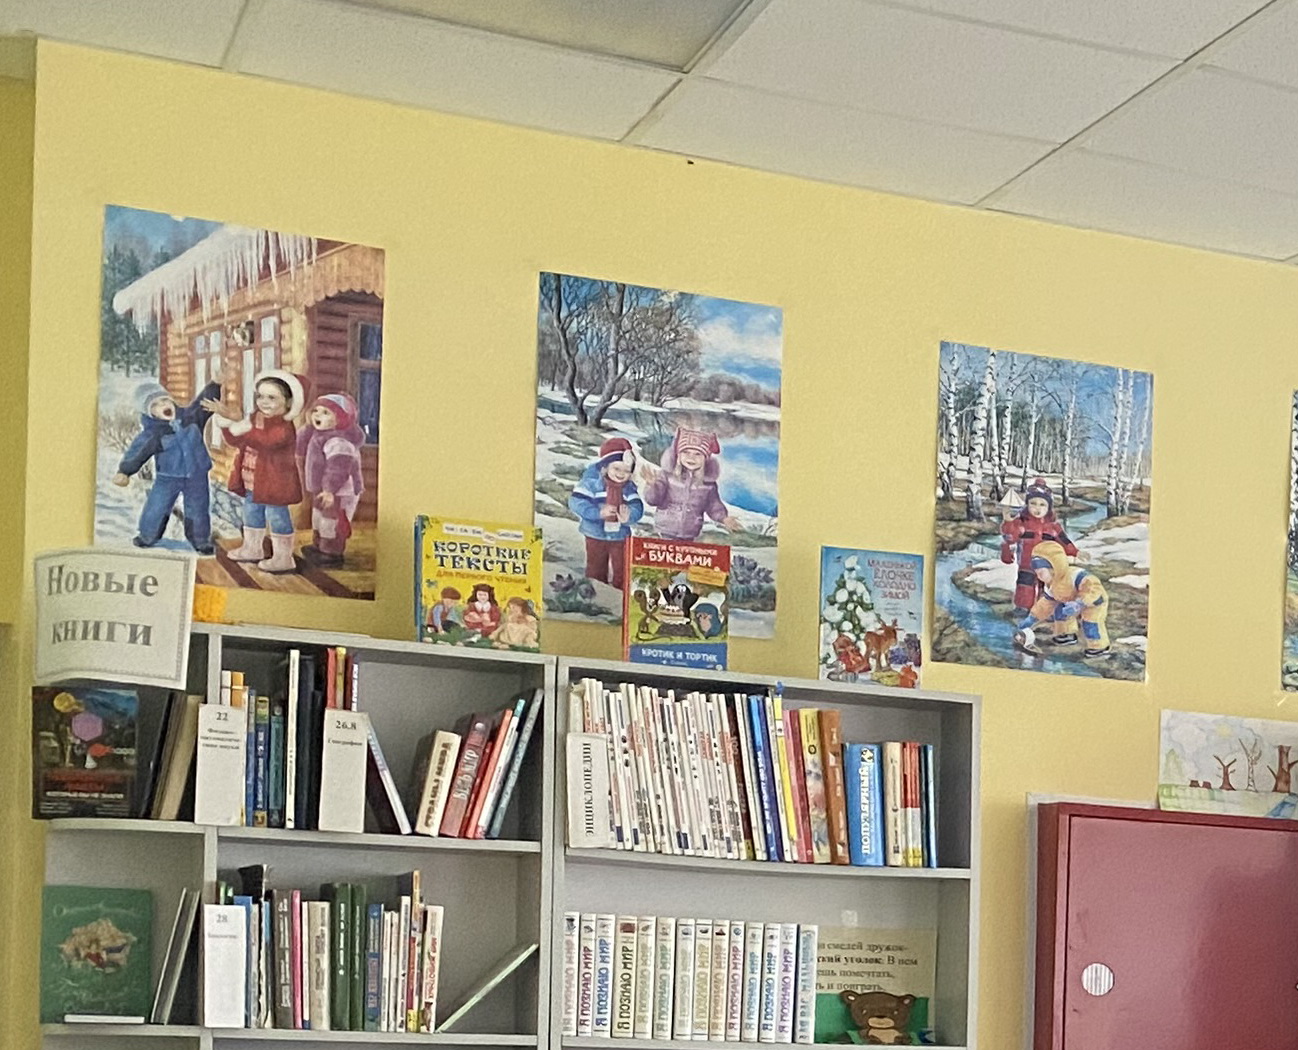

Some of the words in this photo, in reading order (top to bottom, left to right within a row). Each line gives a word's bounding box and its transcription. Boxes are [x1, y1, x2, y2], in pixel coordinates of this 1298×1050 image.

[433, 541, 531, 560] КОРОТКИЕ
[648, 550, 712, 567] БУКВАМИ
[434, 554, 527, 575] ТЕКСТЫ
[47, 564, 159, 597] Новые
[52, 620, 152, 646] книги
[641, 648, 675, 659] КРОТИК
[685, 652, 718, 662] ТОРТИК
[216, 712, 229, 721] 22
[335, 720, 357, 730] 26.8
[582, 742, 595, 837] ЭНЦИКЛОПЕДИИ
[858, 766, 872, 855] ПОПУЛЯРНЫЙ
[582, 946, 593, 970] МИР
[598, 939, 610, 964] МИР
[621, 945, 633, 970] МИР
[580, 972, 591, 1016] ПОЗНАЮ
[597, 967, 609, 1015] ПОЗНАЮ
[618, 972, 632, 1019] ПОЗНАЮ
[579, 1019, 590, 1027] Я
[595, 1018, 608, 1026] Я
[617, 1022, 630, 1030] Я
